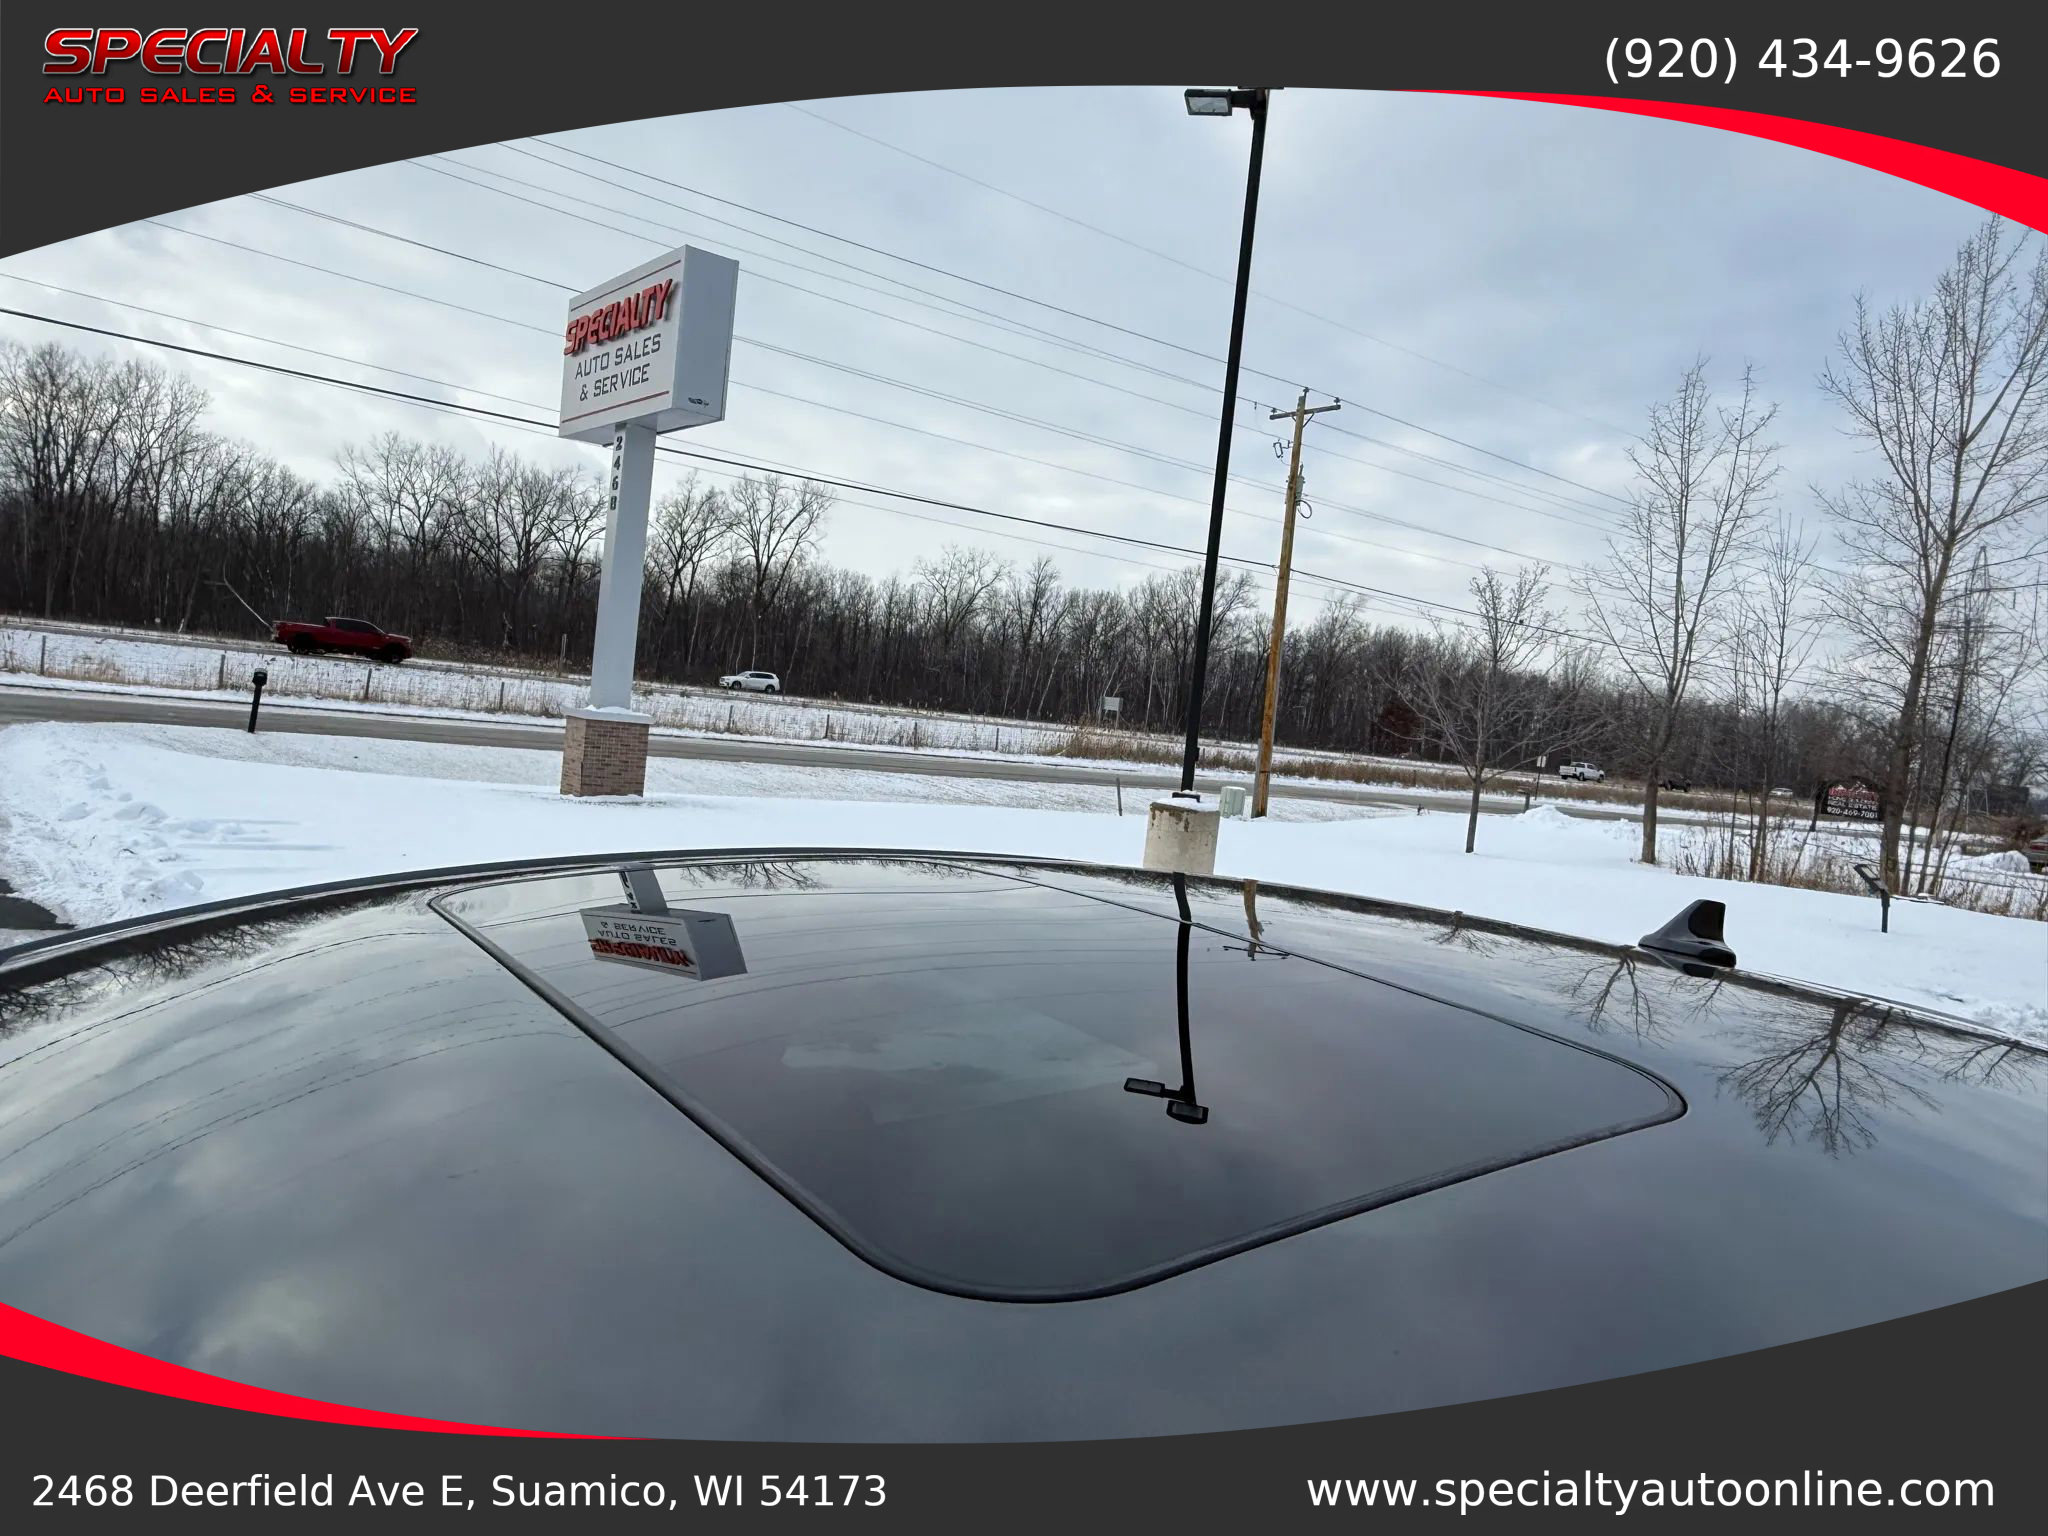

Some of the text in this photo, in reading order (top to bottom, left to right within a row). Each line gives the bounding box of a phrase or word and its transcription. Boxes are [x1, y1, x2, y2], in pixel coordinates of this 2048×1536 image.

[563, 278, 673, 356] SPECIALTY
[574, 333, 662, 380] AUTO SALES
[579, 363, 651, 402] & SERVICE
